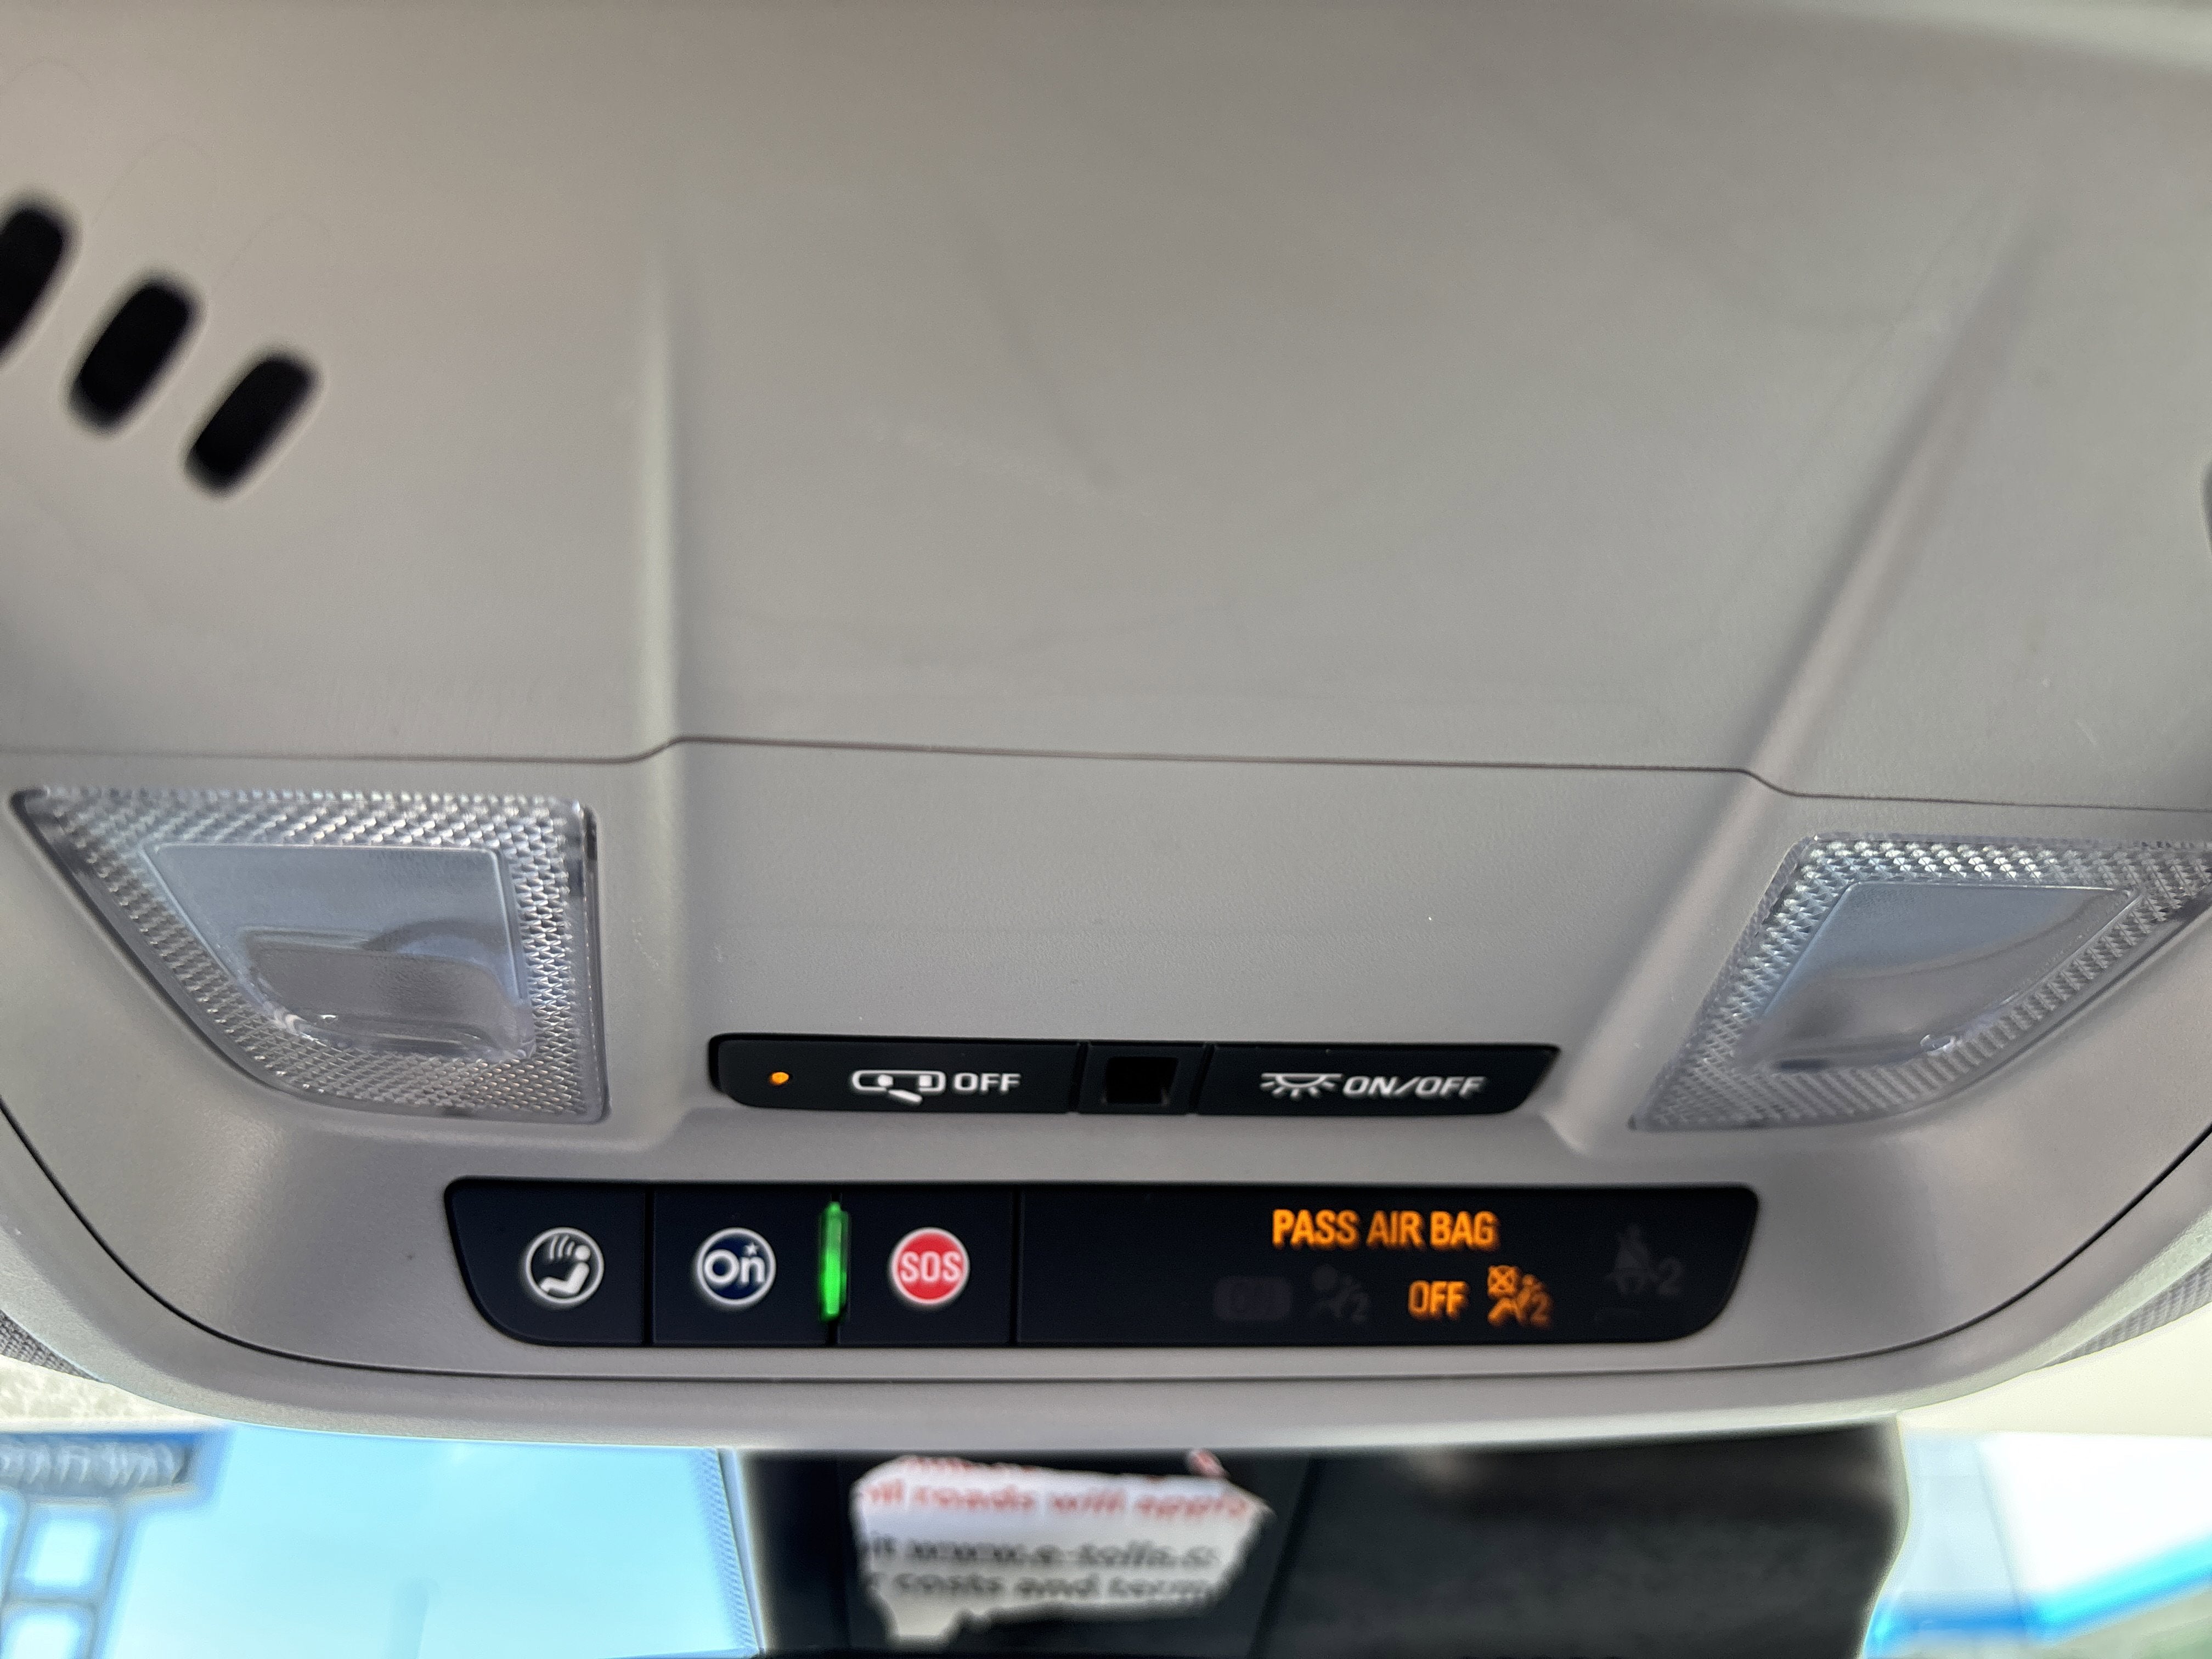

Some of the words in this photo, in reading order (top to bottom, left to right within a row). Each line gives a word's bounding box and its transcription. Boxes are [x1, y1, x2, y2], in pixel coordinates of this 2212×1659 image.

[953, 1072, 1022, 1093] OFF
[1342, 1075, 1487, 1097] ON/OFF
[1272, 1209, 1359, 1248] PASS
[1367, 1210, 1425, 1249] AIR
[1430, 1210, 1499, 1251] BAG
[703, 1248, 766, 1286] On
[899, 1250, 963, 1285] SOS
[1408, 1279, 1469, 1319] OFF
[1049, 1488, 1126, 1515] will
[1017, 1574, 1099, 1598] and
[1107, 1576, 1216, 1600] term
